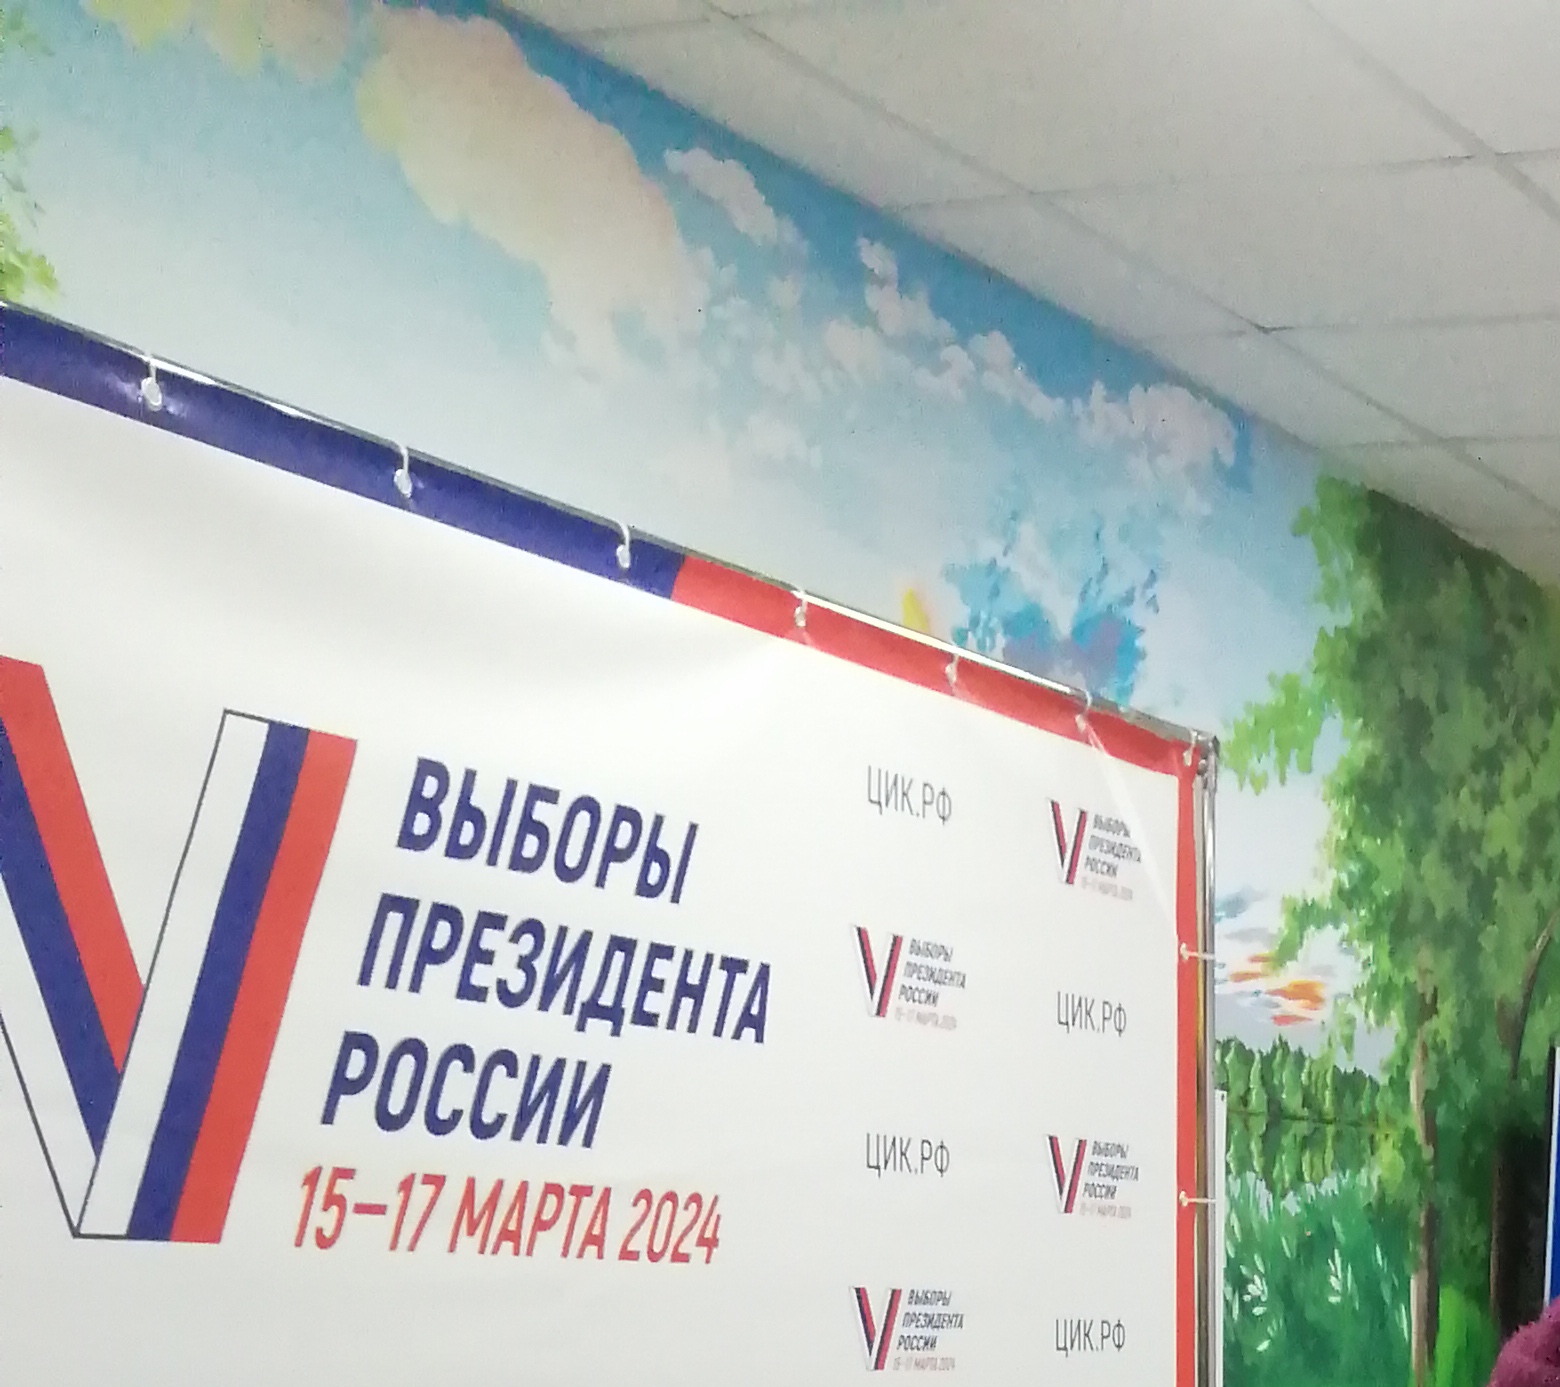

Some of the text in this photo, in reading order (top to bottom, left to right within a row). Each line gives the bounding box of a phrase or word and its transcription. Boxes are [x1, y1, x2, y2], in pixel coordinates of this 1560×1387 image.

[867, 765, 953, 825] ЦИК.РФ
[396, 756, 700, 905] ВЫБОРЫ
[357, 892, 773, 1045] ПРЕЗИДЕНТА
[910, 937, 953, 962] ВЫБОРЫ
[898, 983, 939, 1007] РОССИИ
[904, 960, 966, 989] ПРЕЗИДЕНТА
[1056, 989, 1128, 1037] ЦИК.РФ
[320, 1030, 613, 1150] РОССИИ
[865, 1131, 951, 1179] ЦИК.РФ
[1088, 1161, 1139, 1182] ПРЕЗИДЕНТА
[292, 1164, 724, 1268] 15–17 МАРТА 2024
[908, 1289, 952, 1306] ВЫБОРЫ
[902, 1312, 964, 1331] ПРЕЗИДЕНТА
[1055, 1317, 1127, 1359] ЦИК.РФ
[897, 1335, 938, 1351] РОССИИ
